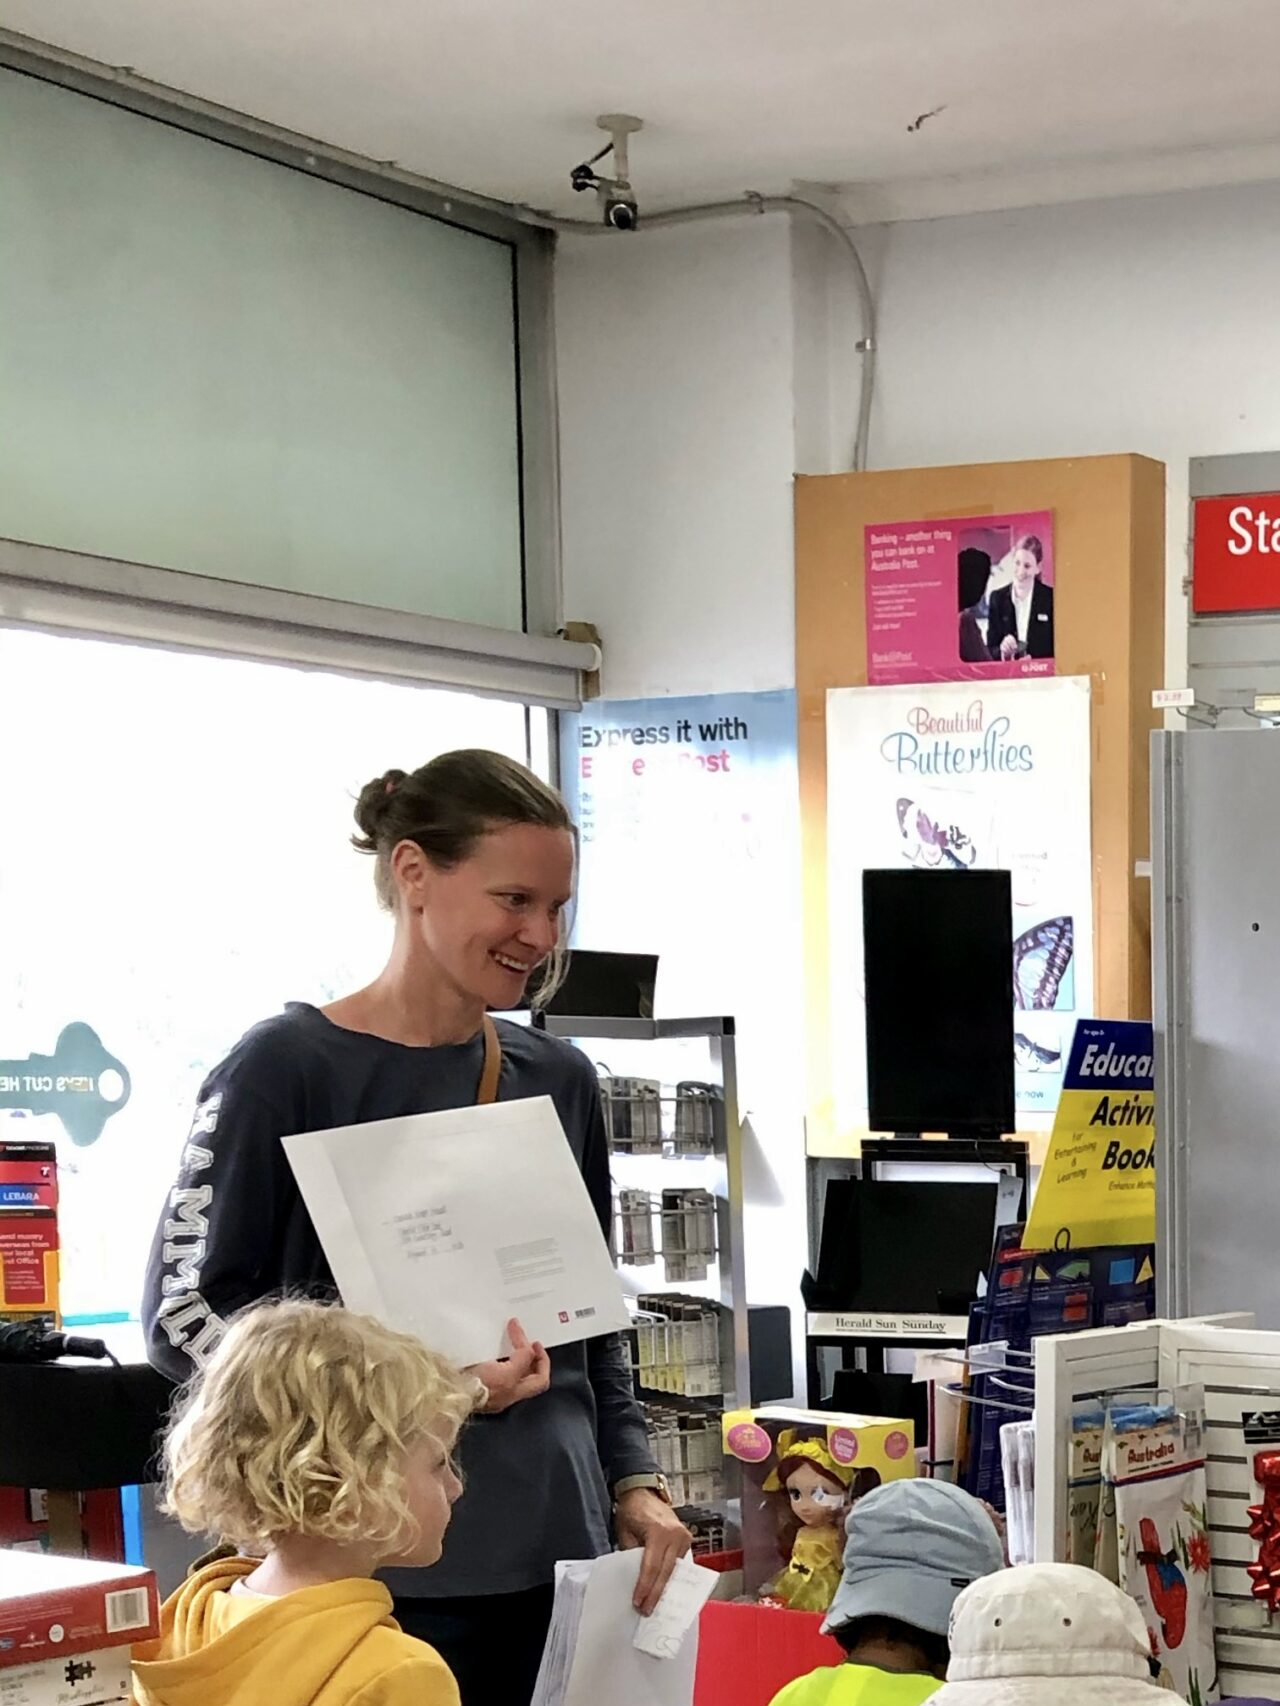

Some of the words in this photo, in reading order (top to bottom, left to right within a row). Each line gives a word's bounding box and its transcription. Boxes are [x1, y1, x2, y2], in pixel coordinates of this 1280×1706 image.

[907, 700, 983, 735] Beautiful
[676, 719, 692, 743] it
[698, 717, 748, 741] with
[880, 716, 1033, 775] Butterflies
[1079, 1042, 1155, 1078] Educa
[1057, 1168, 1088, 1184] Learning
[3, 1192, 40, 1201] LEBARA
[835, 1317, 873, 1329] Herald
[875, 1318, 897, 1329] Sun
[902, 1318, 946, 1332] Sunday
[1127, 1442, 1175, 1464] Australia
